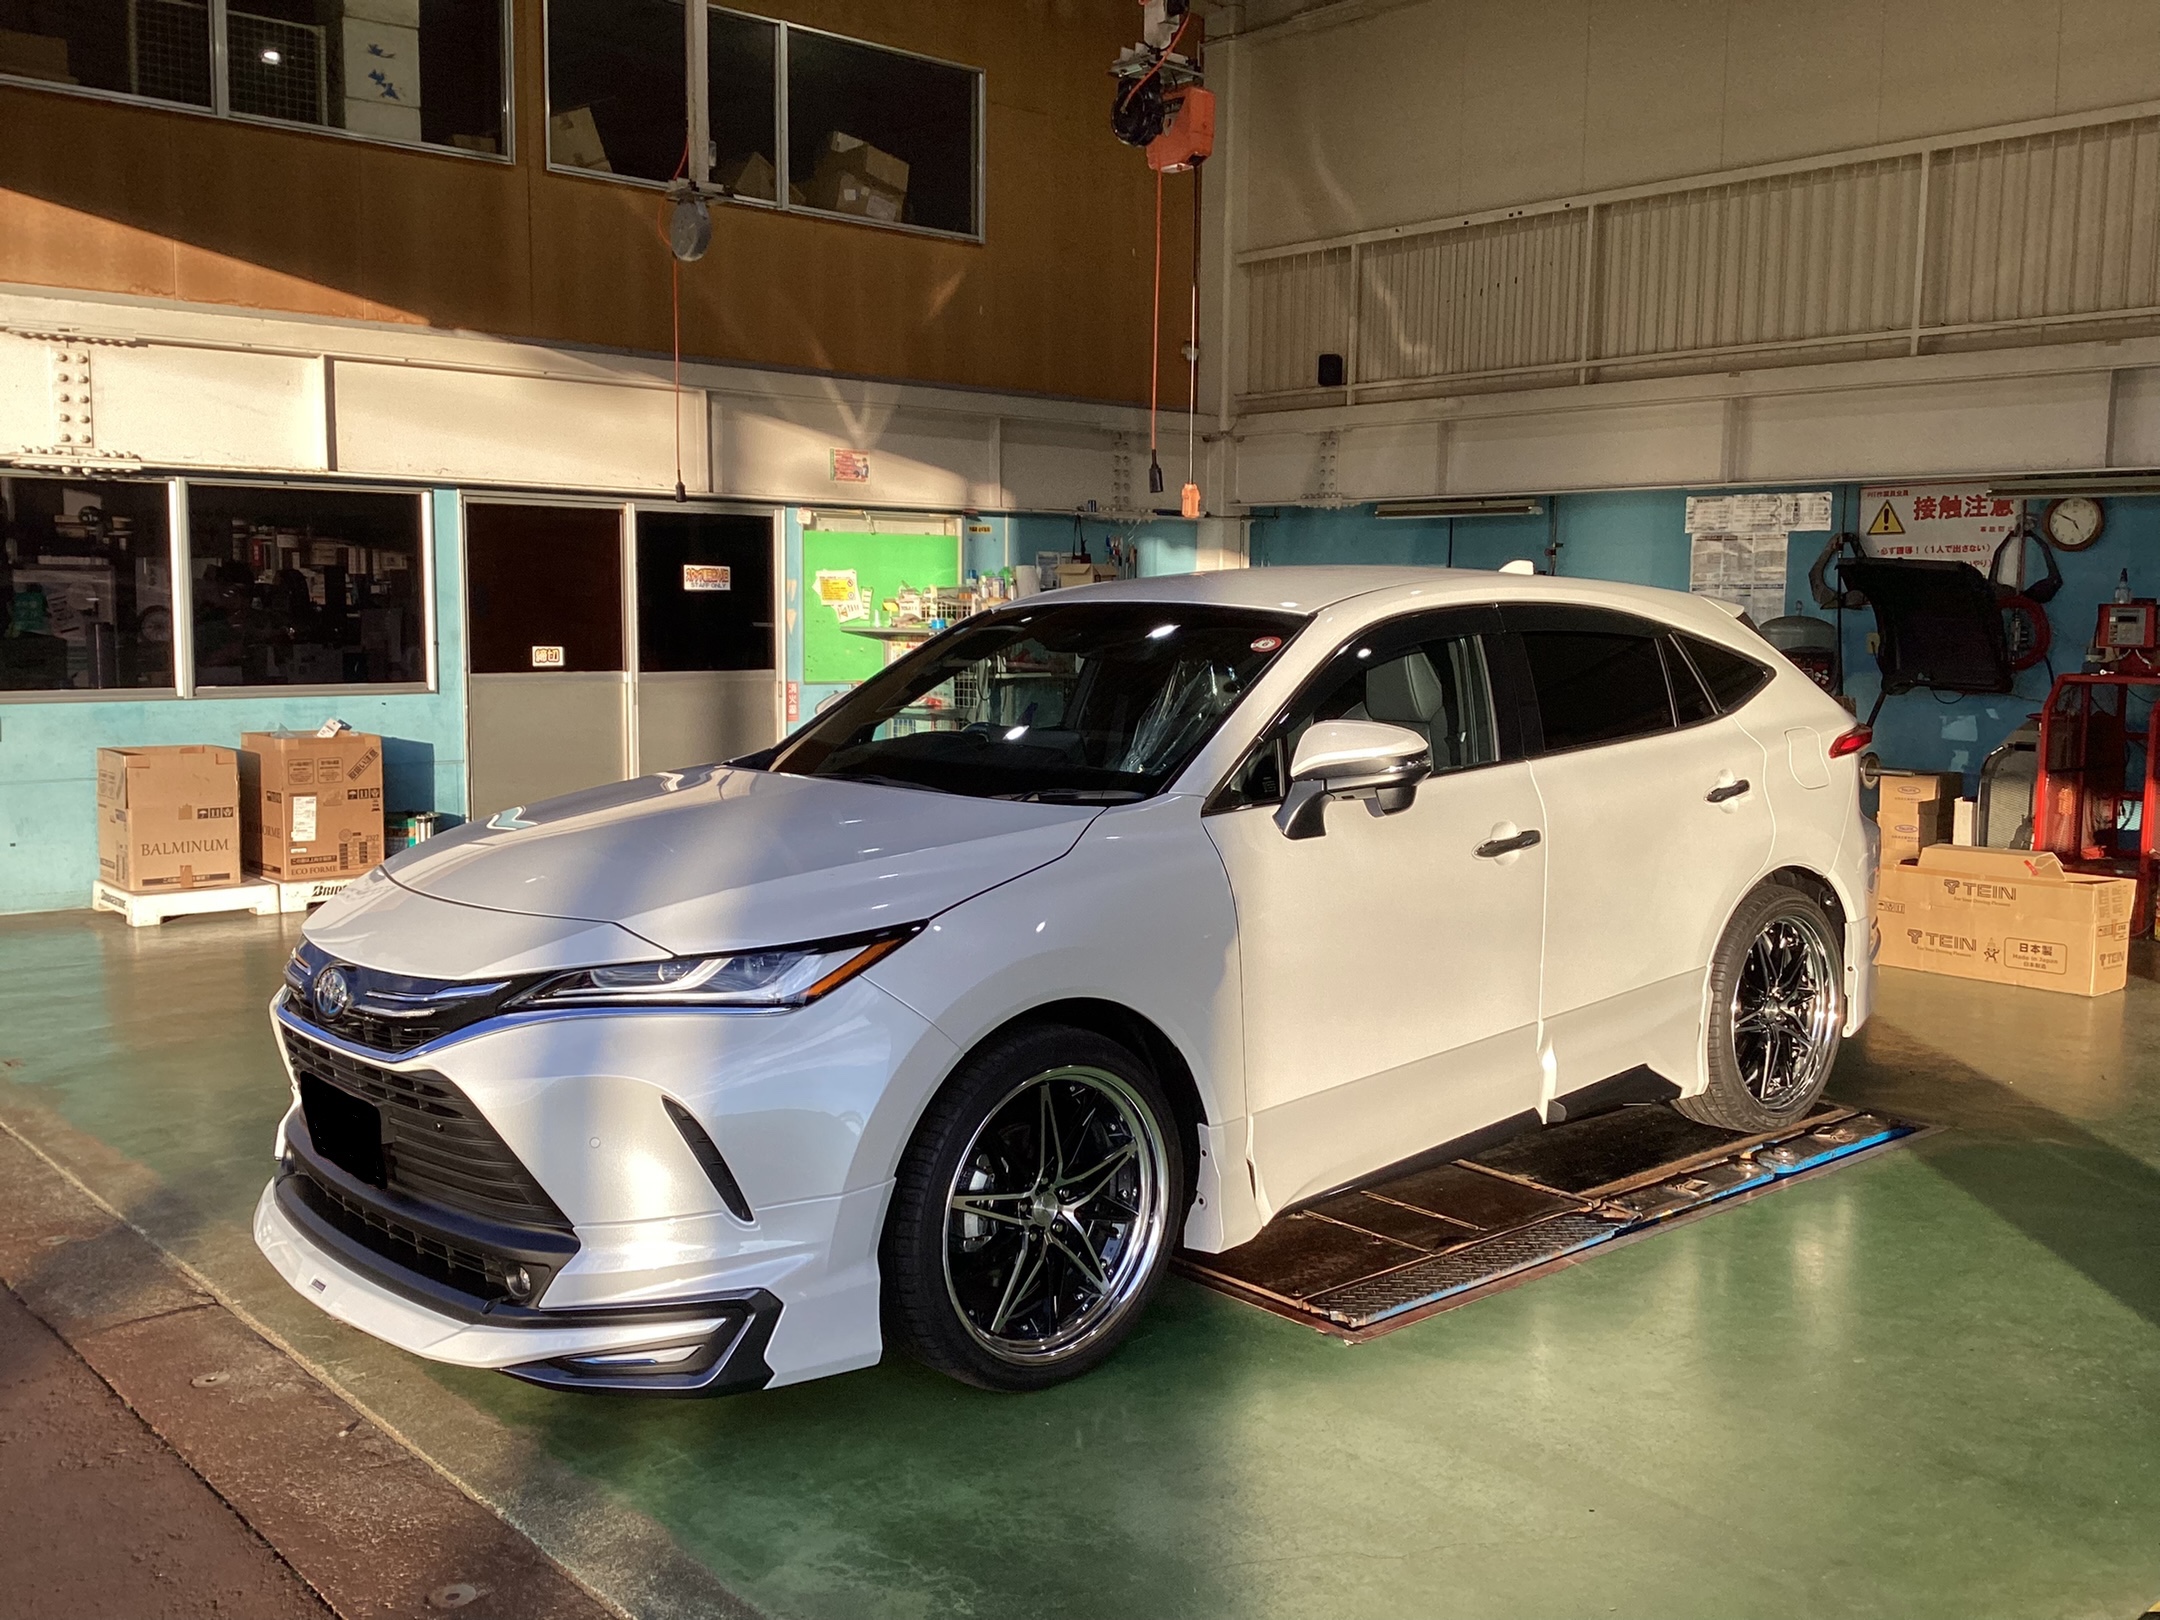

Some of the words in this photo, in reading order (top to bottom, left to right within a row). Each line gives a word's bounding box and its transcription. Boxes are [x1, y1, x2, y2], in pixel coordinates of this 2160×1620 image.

[1913, 494, 2015, 521] 接触注意
[141, 838, 229, 857] BALMINUM
[291, 867, 308, 876] ECO
[310, 865, 338, 874] FORME
[1962, 881, 2017, 901] TEIN
[1926, 931, 1977, 951] TEIN
[2019, 942, 2053, 956] 日本製
